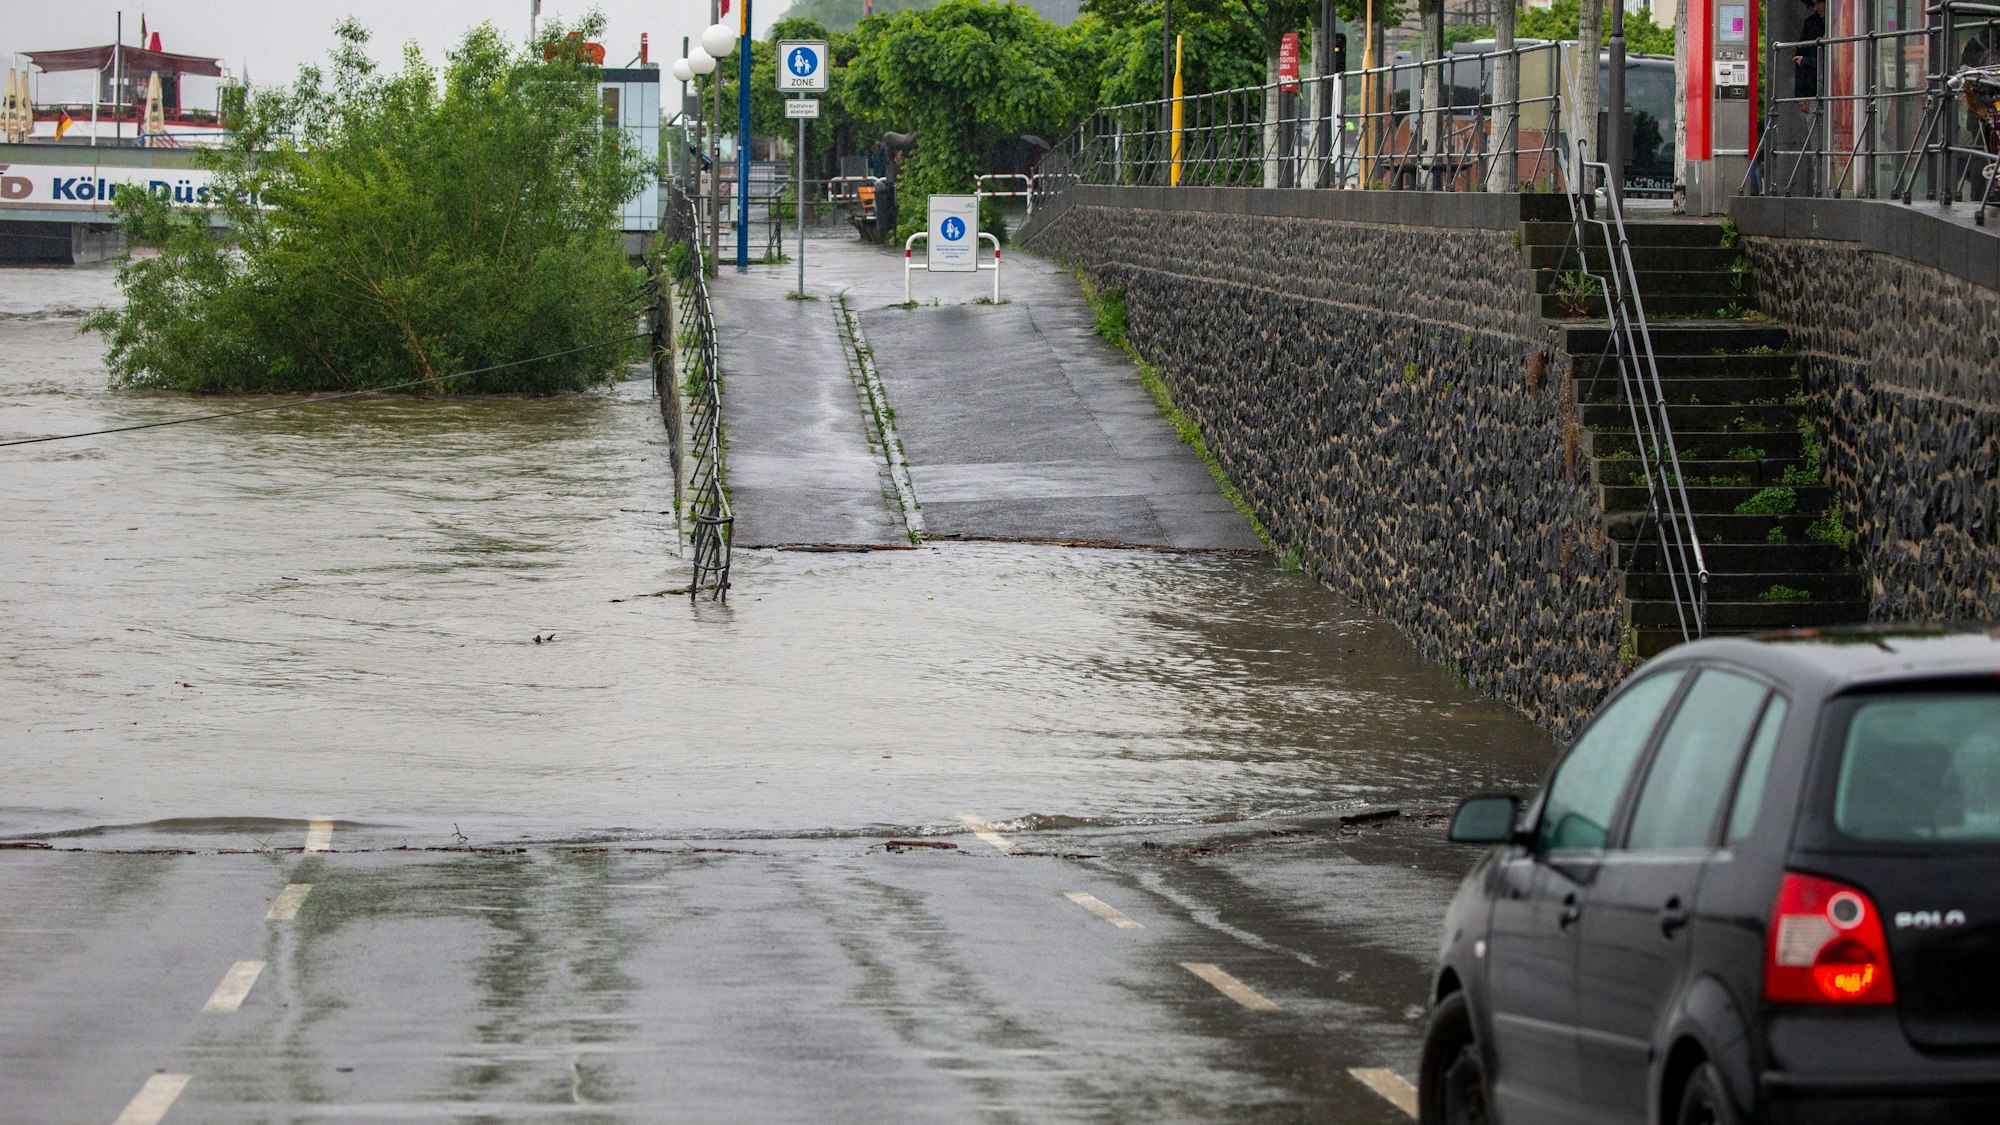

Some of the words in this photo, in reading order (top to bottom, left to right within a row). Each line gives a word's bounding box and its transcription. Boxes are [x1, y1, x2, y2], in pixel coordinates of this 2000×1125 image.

[791, 78, 814, 86] ZONE
[53, 176, 124, 200] Köln
[1894, 909, 1966, 929] POLO
